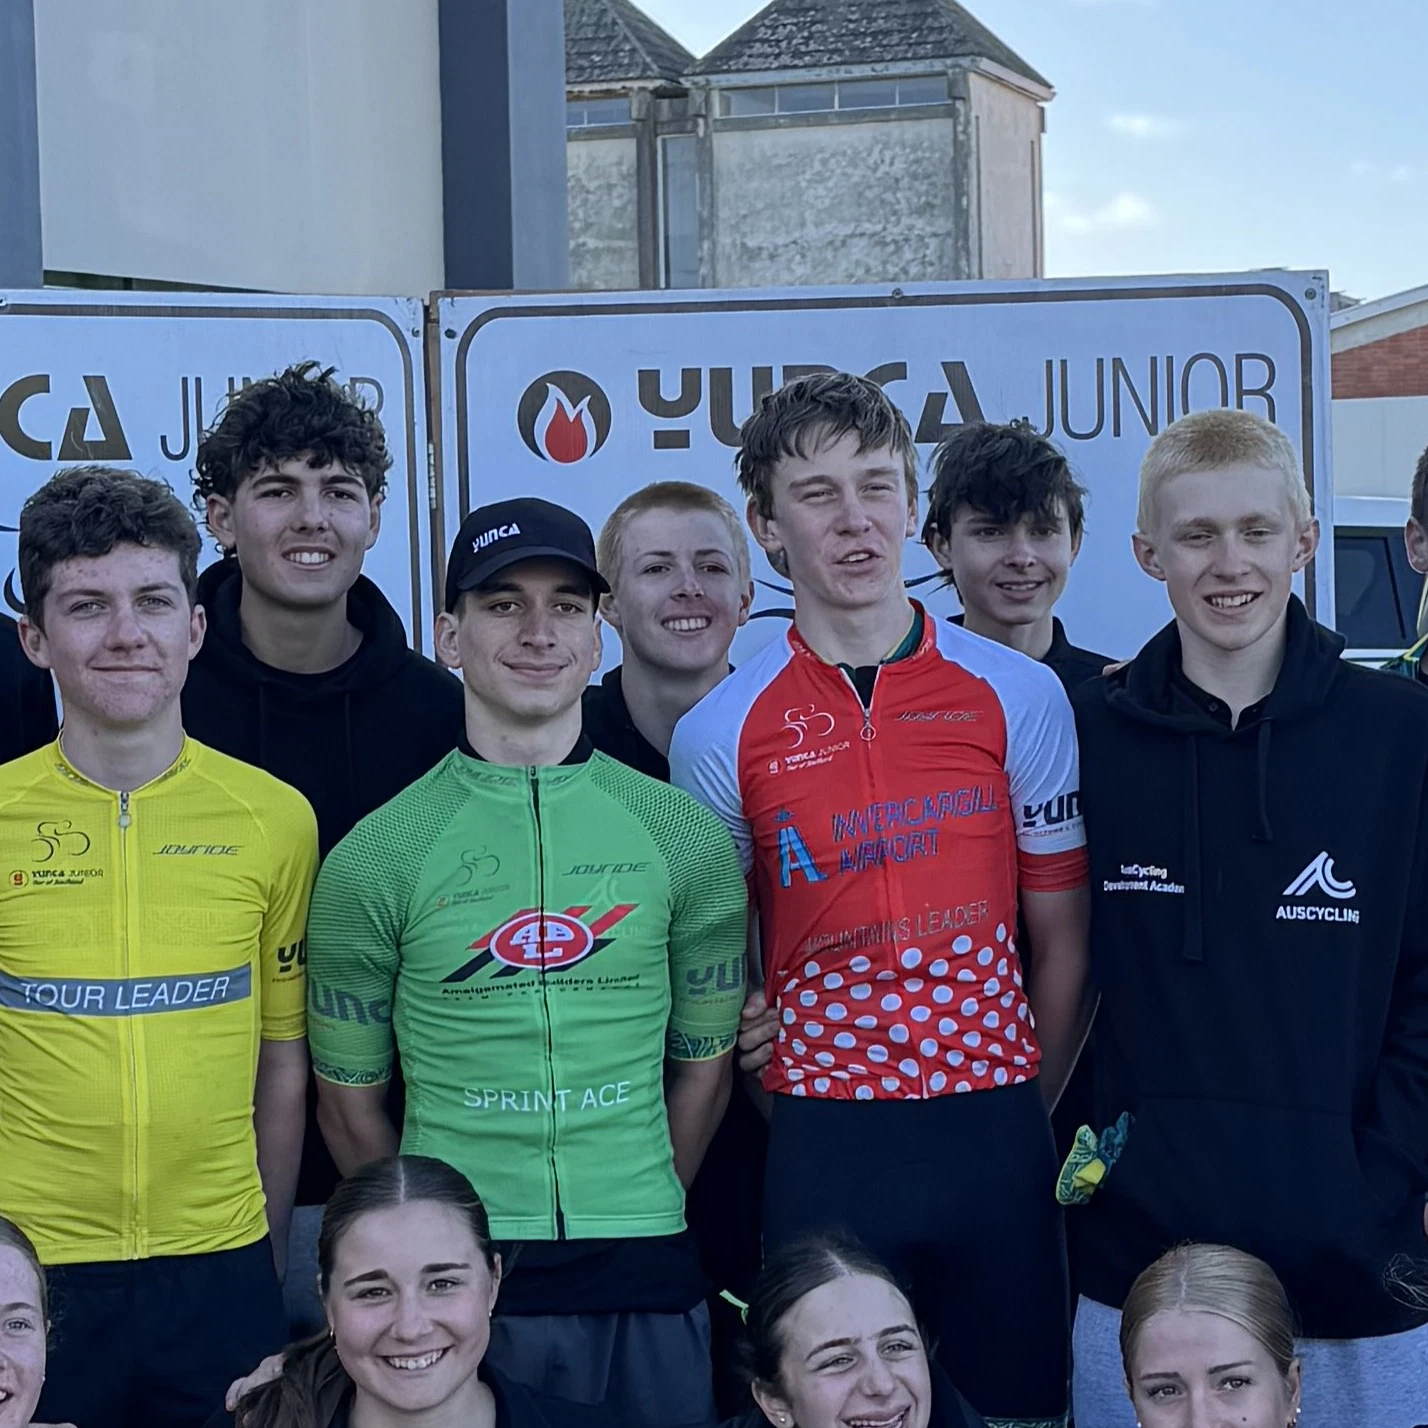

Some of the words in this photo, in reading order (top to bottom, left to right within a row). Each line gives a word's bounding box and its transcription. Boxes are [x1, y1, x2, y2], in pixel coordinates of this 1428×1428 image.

[472, 522, 521, 554] YUNCA
[20, 983, 106, 1010] TOUR
[115, 975, 231, 1011] LEADER
[463, 1087, 572, 1112] SPRINT
[581, 1080, 631, 1111] ACE
